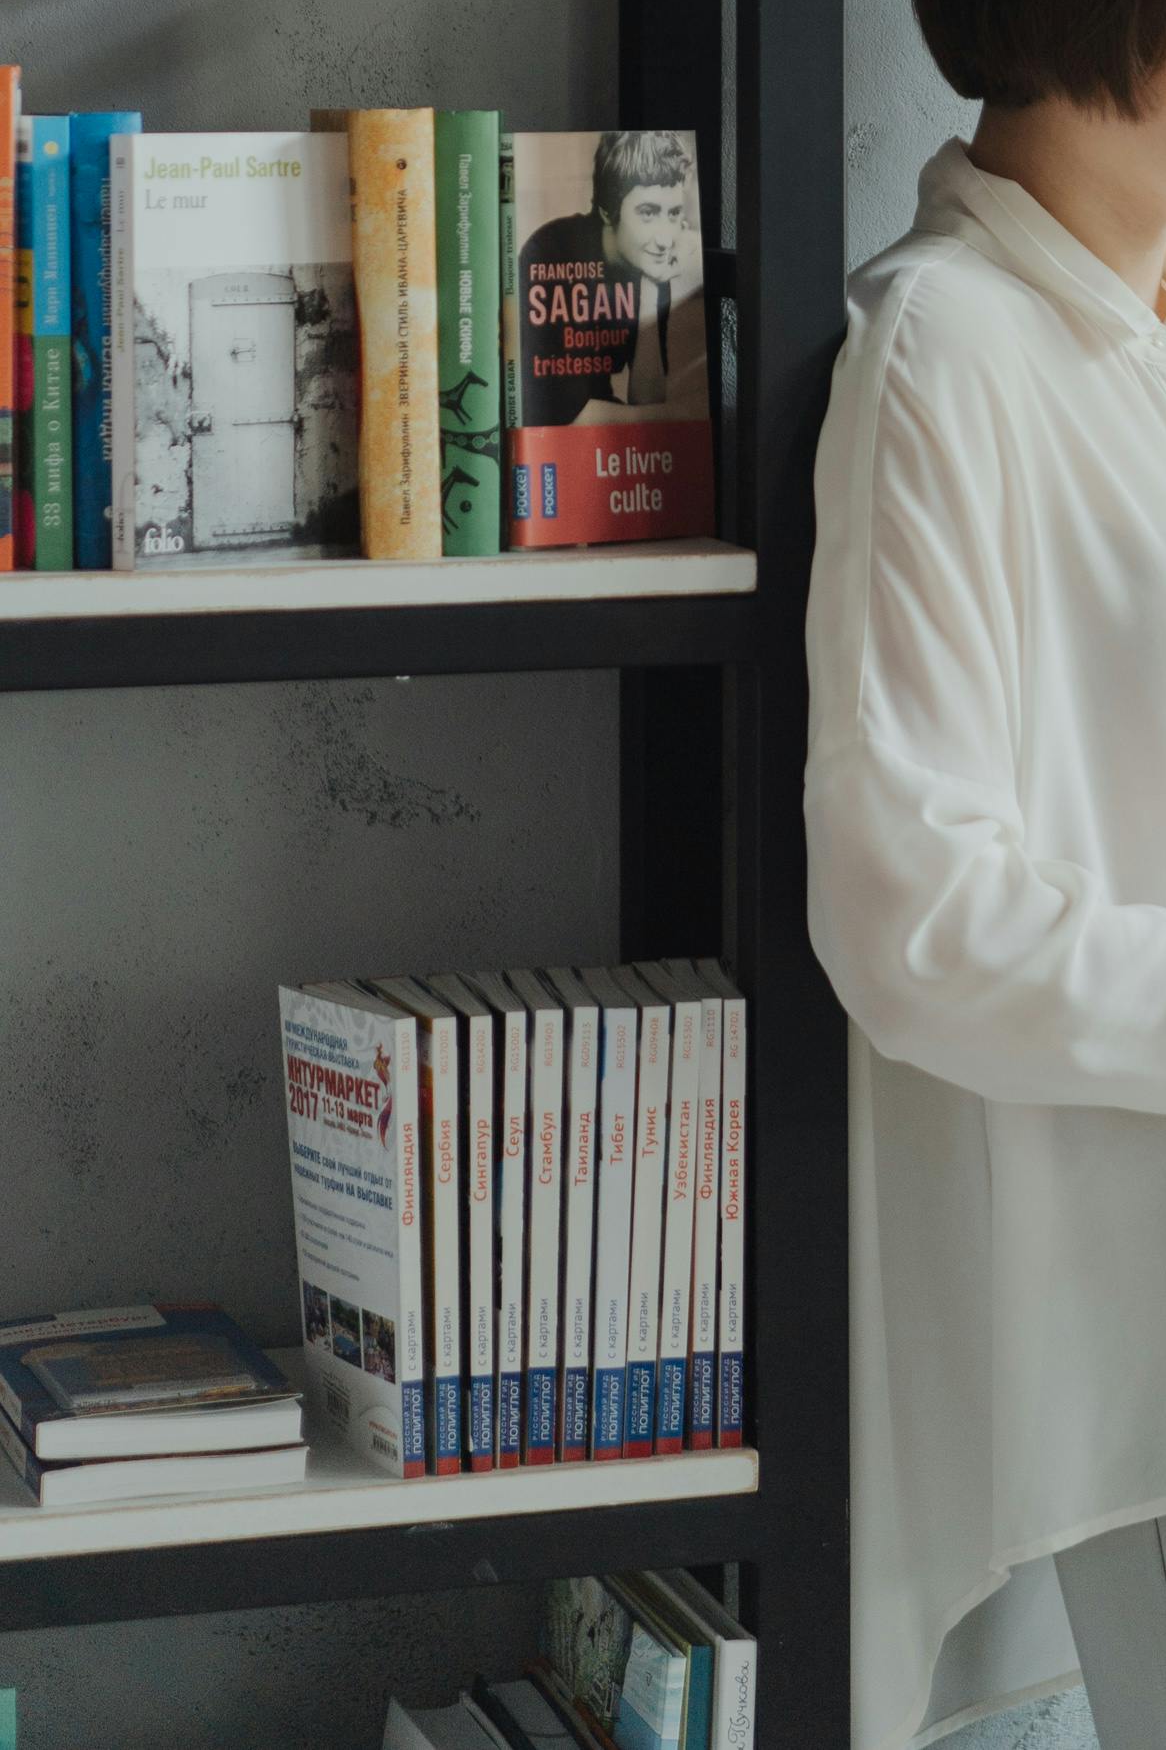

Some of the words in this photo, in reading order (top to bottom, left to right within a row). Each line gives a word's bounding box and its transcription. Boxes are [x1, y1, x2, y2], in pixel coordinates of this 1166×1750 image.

[144, 156, 240, 179] Jean-Paul
[245, 156, 302, 178] Sartre
[459, 154, 471, 190] Павел
[144, 190, 168, 210] Le
[172, 193, 208, 210] mur
[398, 189, 409, 299] ИВАНА-ЦАРЕВИЧА
[456, 192, 472, 264] Зарифуллин
[460, 269, 472, 313] НОВЫЕ
[505, 257, 513, 295] Bonjour
[529, 260, 605, 283] FRANÇOISE
[399, 302, 409, 345] СТИЛЬ
[528, 281, 636, 326] SAGAN
[459, 317, 472, 365] СКИФЫ
[563, 326, 630, 351] Bonjour
[42, 348, 61, 411] Китае
[398, 346, 410, 408] ЗВЕРИНЫЙ
[533, 353, 613, 378] tristesse
[48, 420, 61, 431] о
[401, 412, 413, 485] Зарифуллин
[44, 442, 64, 493] мифа
[595, 448, 621, 480] Le
[625, 445, 673, 475] livre
[43, 502, 62, 527] 33
[401, 489, 411, 525] Павел
[609, 482, 663, 514] culte
[144, 527, 184, 553] folio
[287, 1053, 380, 1111] ИНТУРМАРКЕТ
[289, 1081, 318, 1122] 2017
[322, 1096, 345, 1119] 11-13
[346, 1107, 373, 1128] марта
[438, 1120, 453, 1184] Сербия
[506, 1116, 523, 1157] Сеул
[539, 1112, 557, 1185] Стамбул
[575, 1111, 591, 1186] Таиланд
[610, 1113, 624, 1165] Тибет
[642, 1106, 659, 1158] Тунис
[673, 1100, 690, 1200] Узбекистан
[700, 1098, 715, 1200] Финляндия
[727, 1100, 742, 1153] Корея
[402, 1122, 414, 1226] Финляндия
[474, 1120, 492, 1202] Сингапур
[726, 1158, 739, 1220] Южная
[443, 1307, 453, 1356] картами
[478, 1306, 488, 1355] картами
[507, 1302, 518, 1352] картами
[539, 1298, 550, 1348] картами
[574, 1298, 585, 1348] картами
[608, 1299, 619, 1349] картами
[639, 1292, 650, 1343] картами
[671, 1289, 683, 1339] картами
[700, 1283, 711, 1332] картами
[728, 1283, 739, 1332] картами
[408, 1311, 418, 1360] картами
[447, 1383, 456, 1450] ПОЛИГЛОТ
[481, 1383, 490, 1449] ПОЛИГЛОТ
[509, 1379, 520, 1446] ПОЛИГЛОТ
[540, 1374, 551, 1441] ПОЛИГЛОТ
[574, 1374, 585, 1440] ПОЛИГЛОТ
[608, 1375, 619, 1441] ПОЛИГЛОТ
[639, 1368, 650, 1434] ПОЛИГЛОТ
[671, 1365, 682, 1431] ПОЛИГЛОТ
[701, 1359, 711, 1424] ПОЛИГЛОТ
[731, 1359, 740, 1424] ПОЛИГЛОТ
[412, 1388, 421, 1454] ПОЛИГЛОТ
